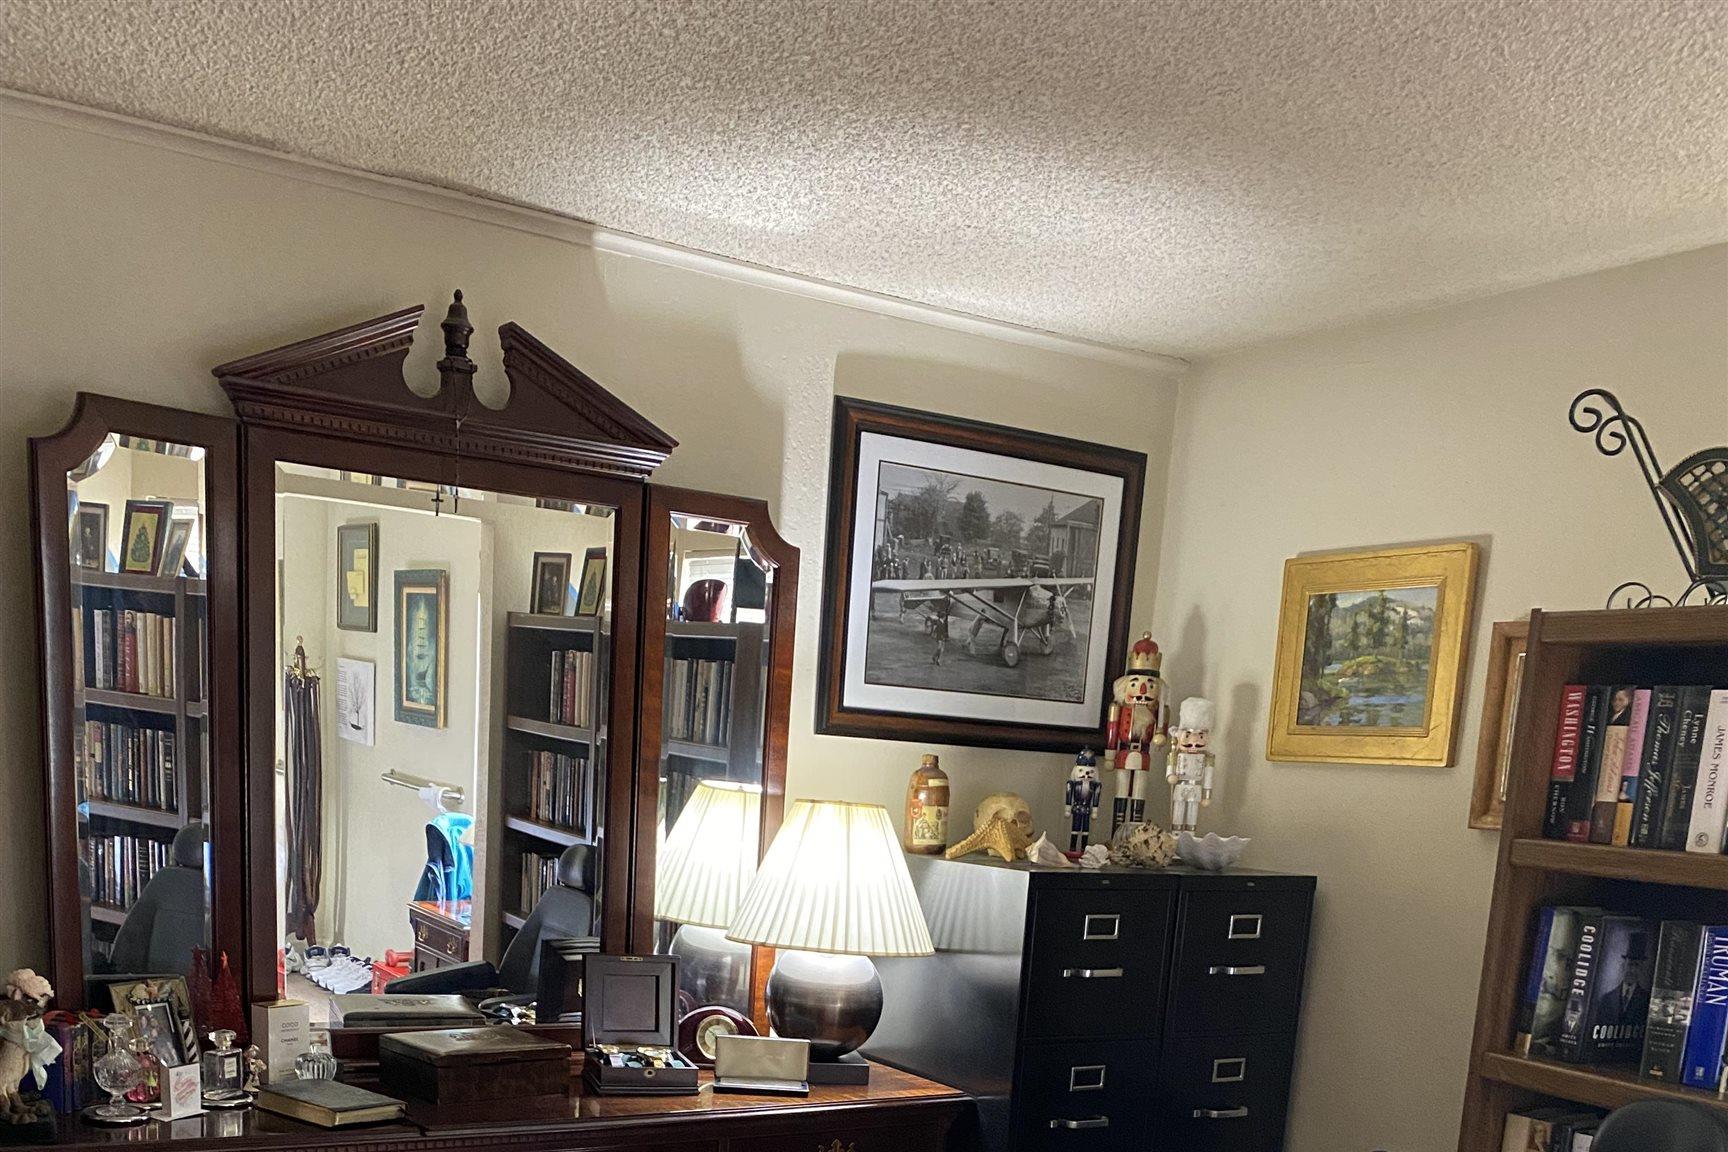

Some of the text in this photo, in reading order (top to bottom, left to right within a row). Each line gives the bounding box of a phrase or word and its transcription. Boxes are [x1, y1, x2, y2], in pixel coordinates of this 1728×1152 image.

[1557, 692, 1582, 770] WASHINGTON
[1652, 712, 1671, 764] Thomas
[1678, 710, 1693, 748] Cheney
[1689, 713, 1704, 745] Lynne
[1641, 763, 1662, 821] Jefferson
[1703, 725, 1727, 810] JAMES MONROE
[1571, 926, 1596, 996] COOLIDGE
[1592, 1024, 1645, 1040] COOLIDGE
